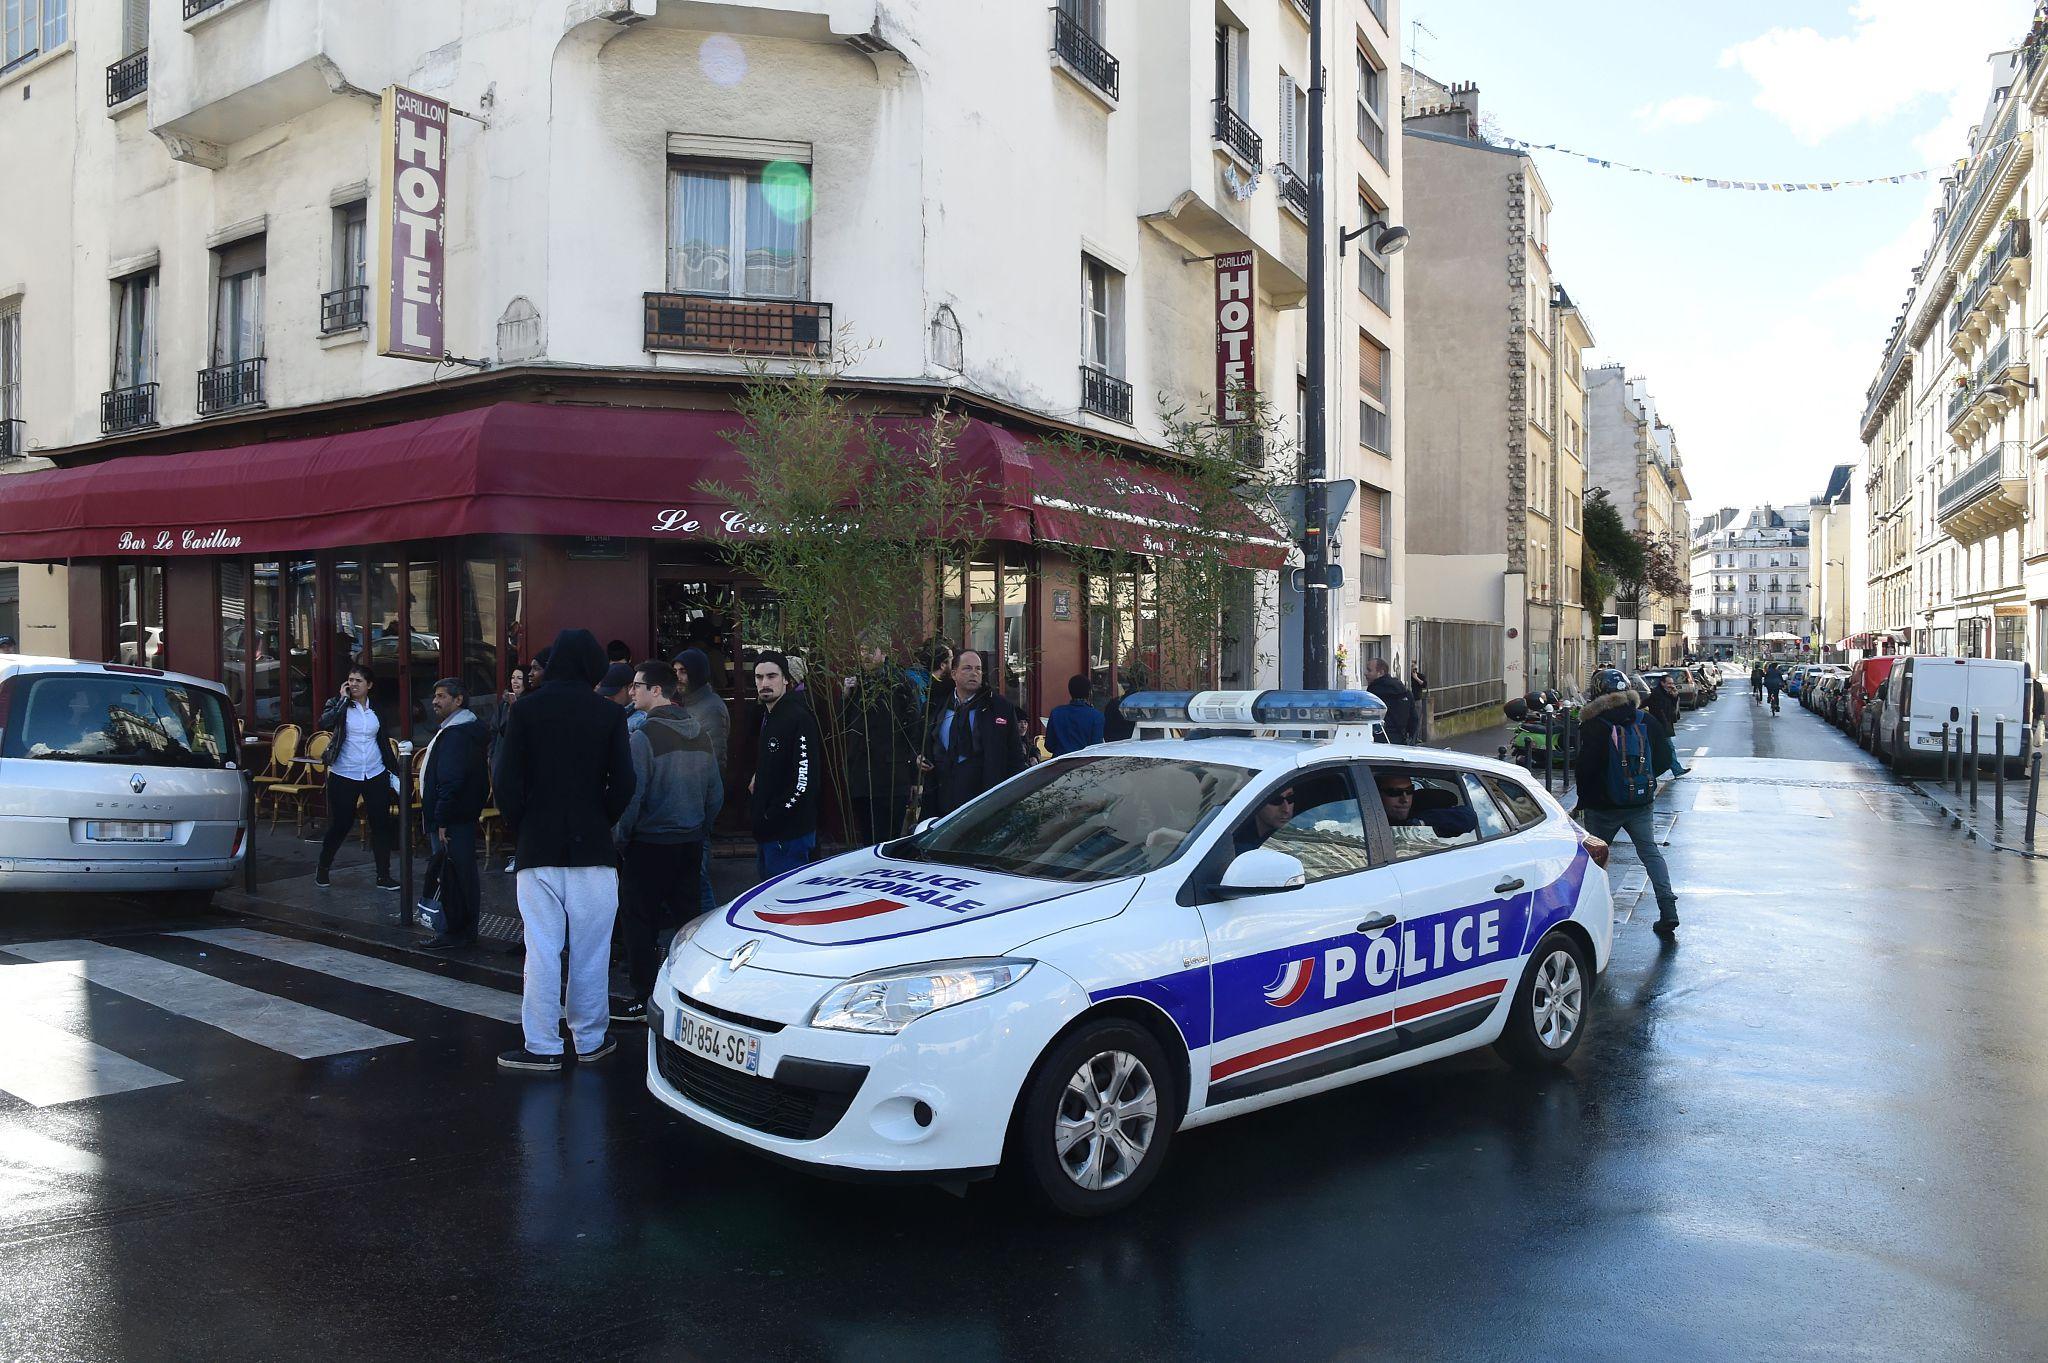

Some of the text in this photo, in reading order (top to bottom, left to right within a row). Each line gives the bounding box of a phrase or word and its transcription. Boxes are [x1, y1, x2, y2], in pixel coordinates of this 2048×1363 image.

[396, 93, 445, 124] CARILLON
[398, 117, 441, 350] HOTEL
[1216, 254, 1252, 269] CARILLON
[1219, 269, 1250, 421] HOTEL
[651, 509, 700, 532] Le
[117, 528, 242, 550] Bar Le Carillon
[796, 759, 809, 793] SUPRA
[798, 876, 987, 914] NATIONALE
[859, 868, 982, 892] POLICE
[1323, 909, 1500, 999] POLICE
